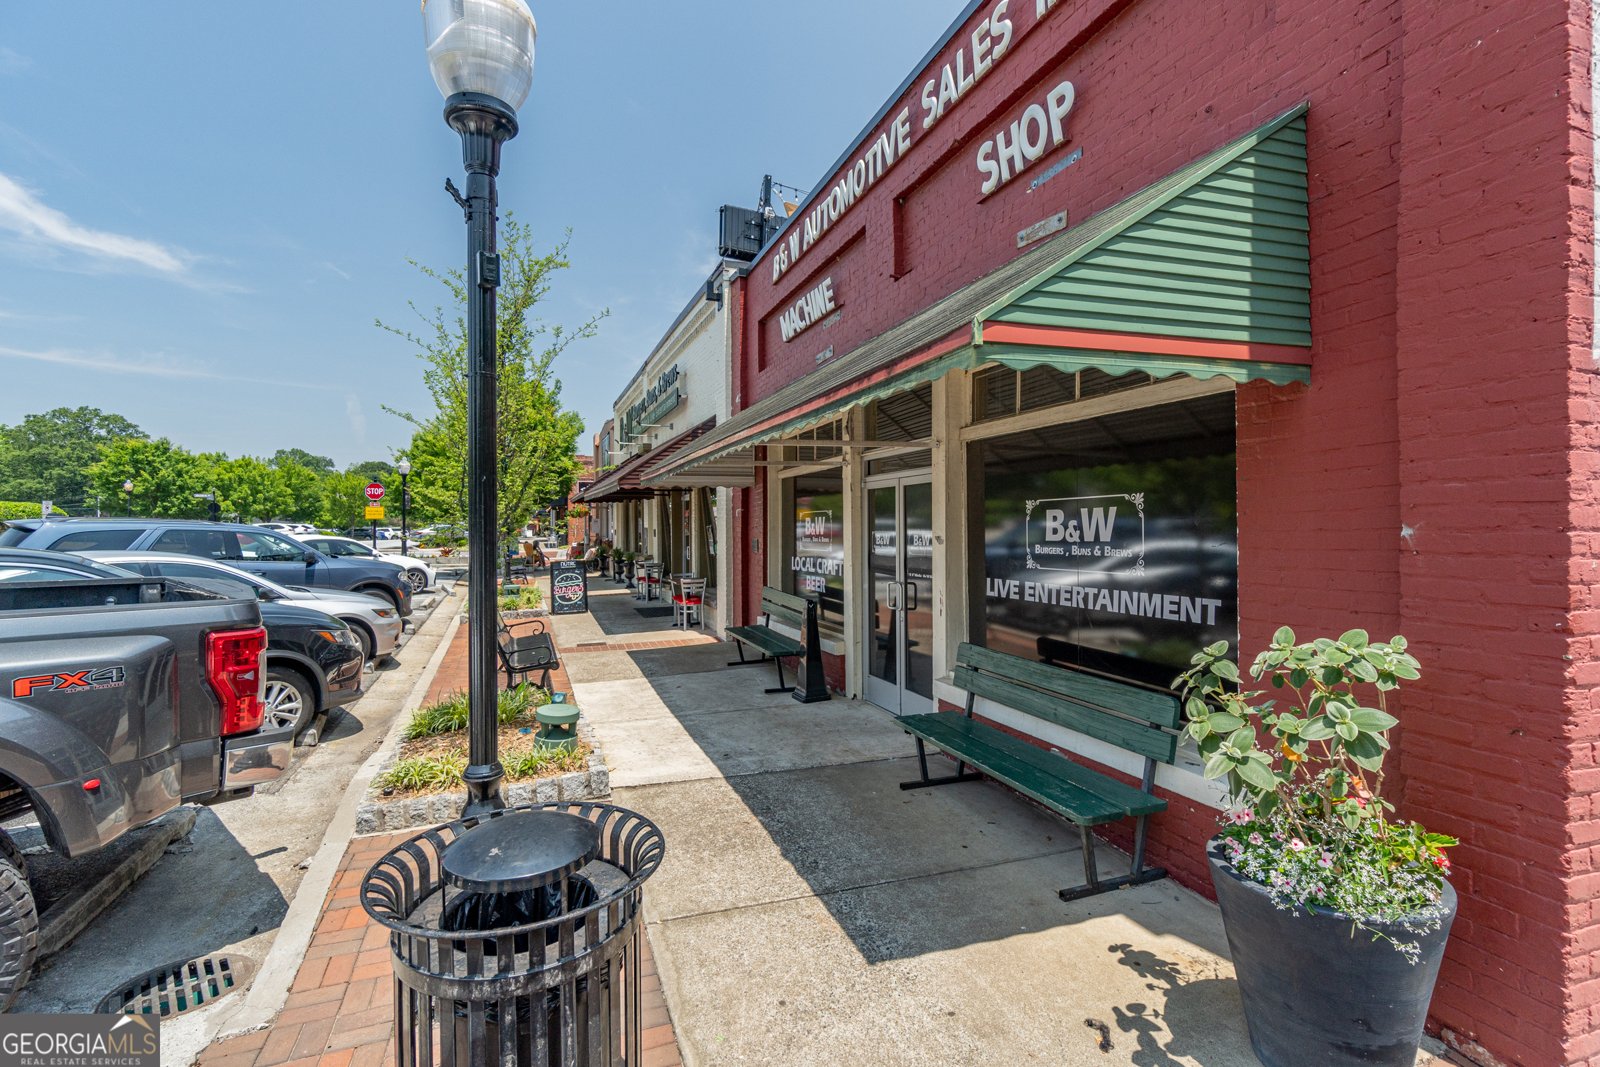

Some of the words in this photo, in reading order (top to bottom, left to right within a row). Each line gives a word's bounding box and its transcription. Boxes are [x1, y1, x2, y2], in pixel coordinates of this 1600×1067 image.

[803, 106, 911, 252] AUTOMOTIVE
[921, 0, 1013, 129] SALES
[976, 80, 1075, 194] SHOP
[780, 276, 835, 342] MACHINE
[366, 487, 384, 495] STOP
[805, 516, 826, 536] B&W
[1045, 506, 1117, 543] B&W
[791, 556, 816, 572] LOCAL
[816, 558, 844, 577] CRAFT
[1094, 545, 1102, 556] &
[806, 575, 826, 593] BEER
[986, 577, 1020, 600] LIVE
[1024, 581, 1222, 626] ENTERTAINMENT
[12, 665, 125, 699] FX4
